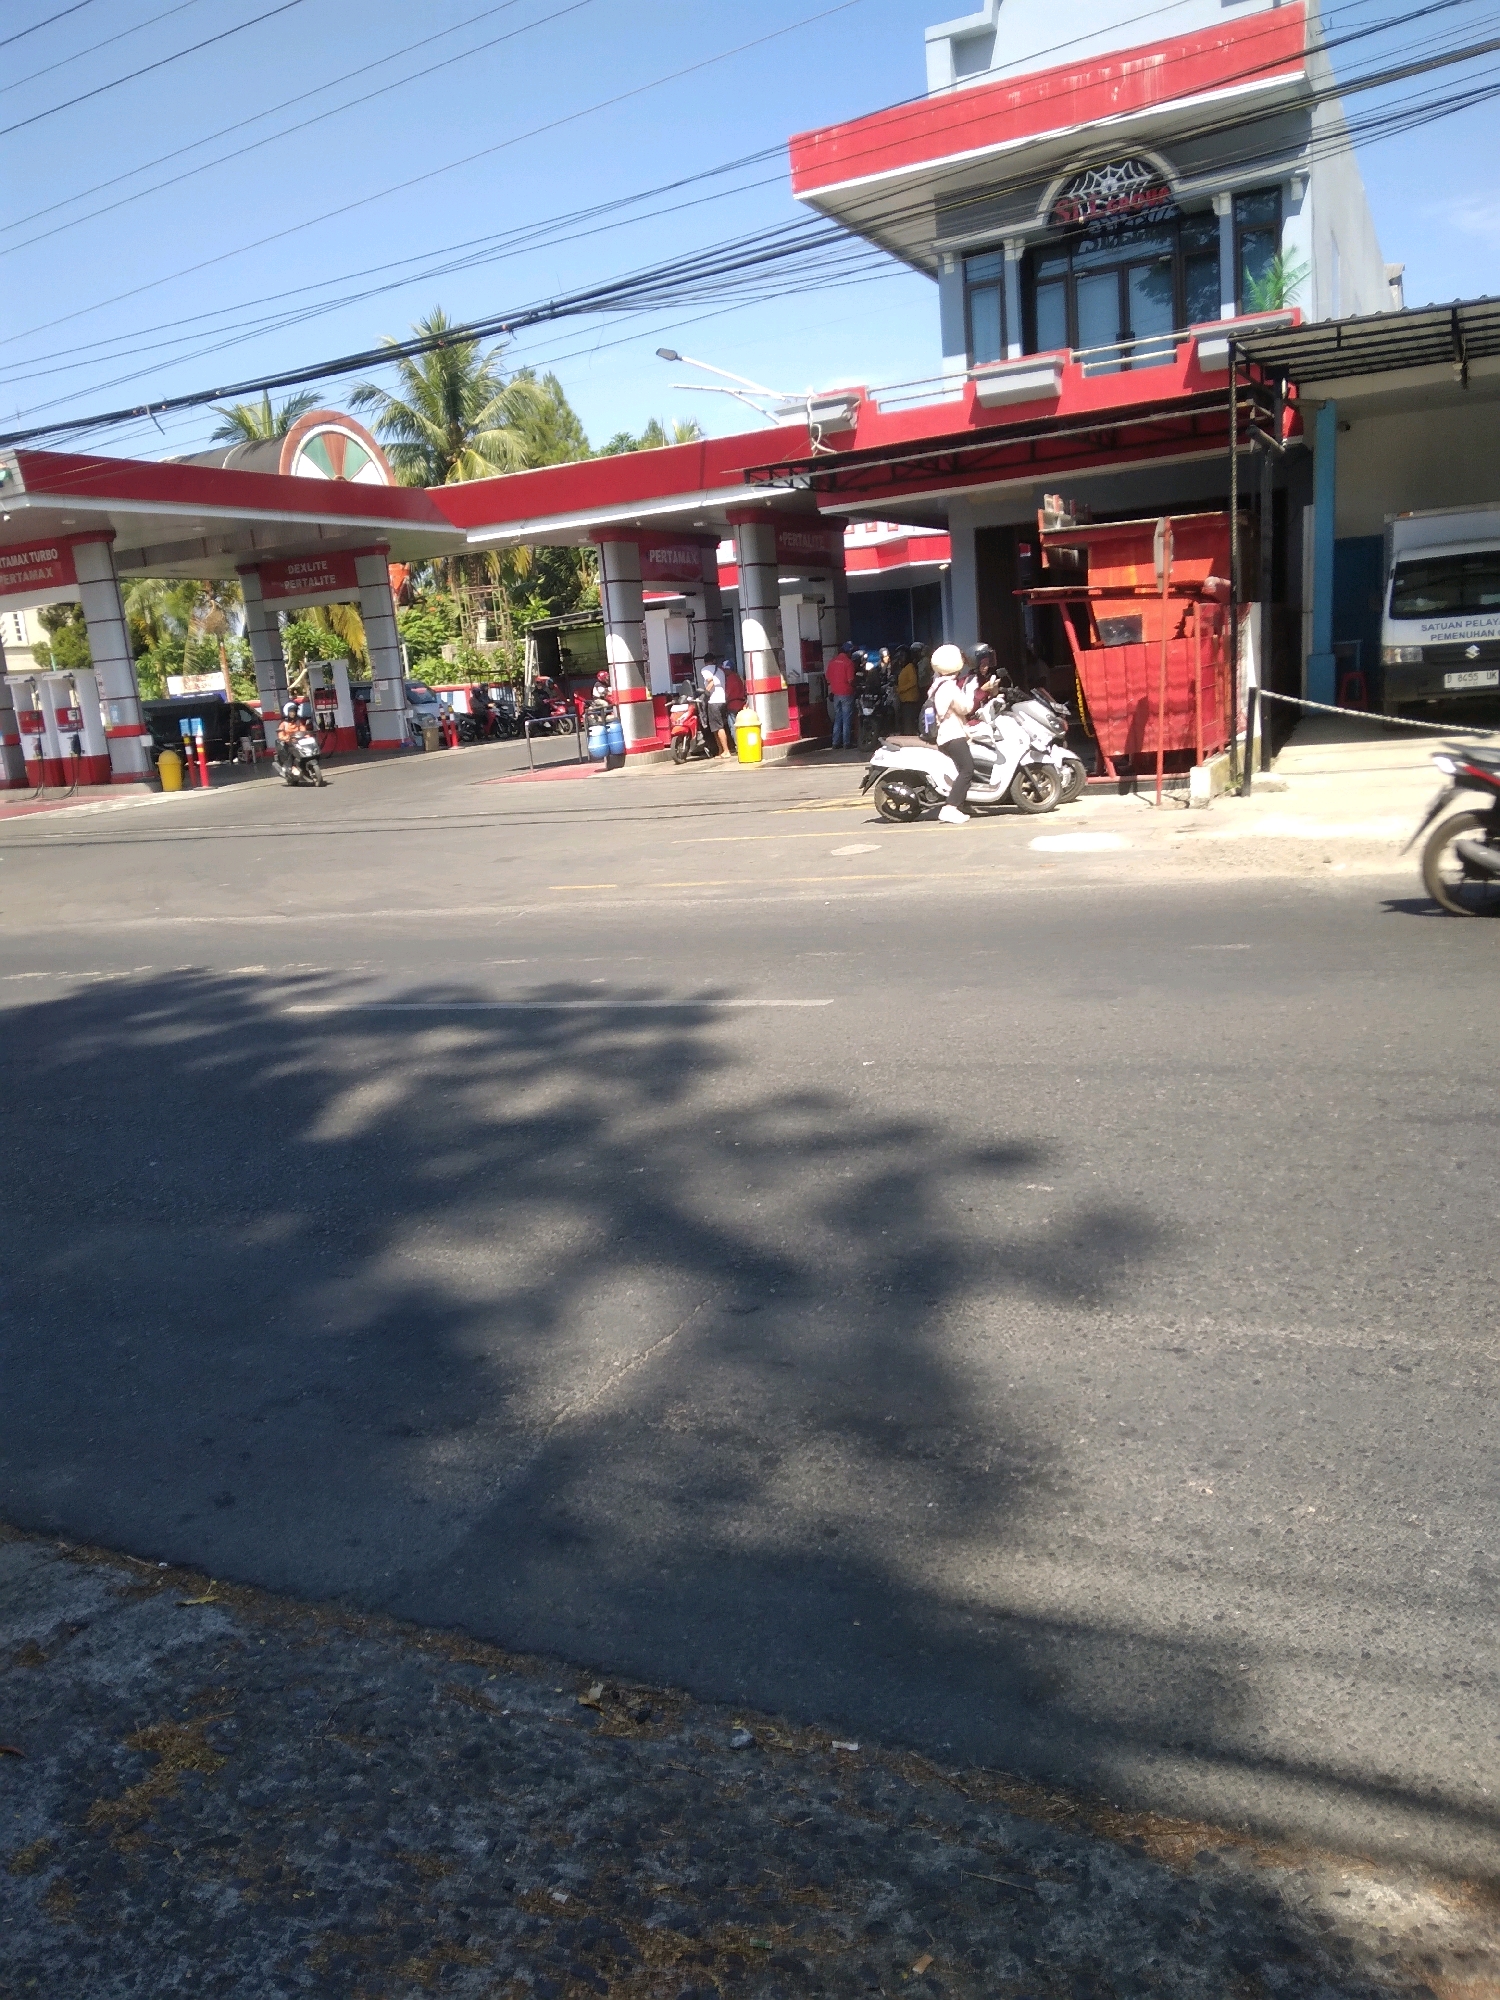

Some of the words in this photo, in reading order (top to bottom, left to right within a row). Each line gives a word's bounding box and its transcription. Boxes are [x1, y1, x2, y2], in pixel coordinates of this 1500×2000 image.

[29, 548, 58, 563] TURBO
[649, 549, 699, 564] PERTAMAX
[287, 560, 328, 575] DEXLITE
[283, 574, 337, 590] PERTALITE
[1421, 621, 1463, 632] SATUAN
[1430, 629, 1495, 641] PEMENUHAN
